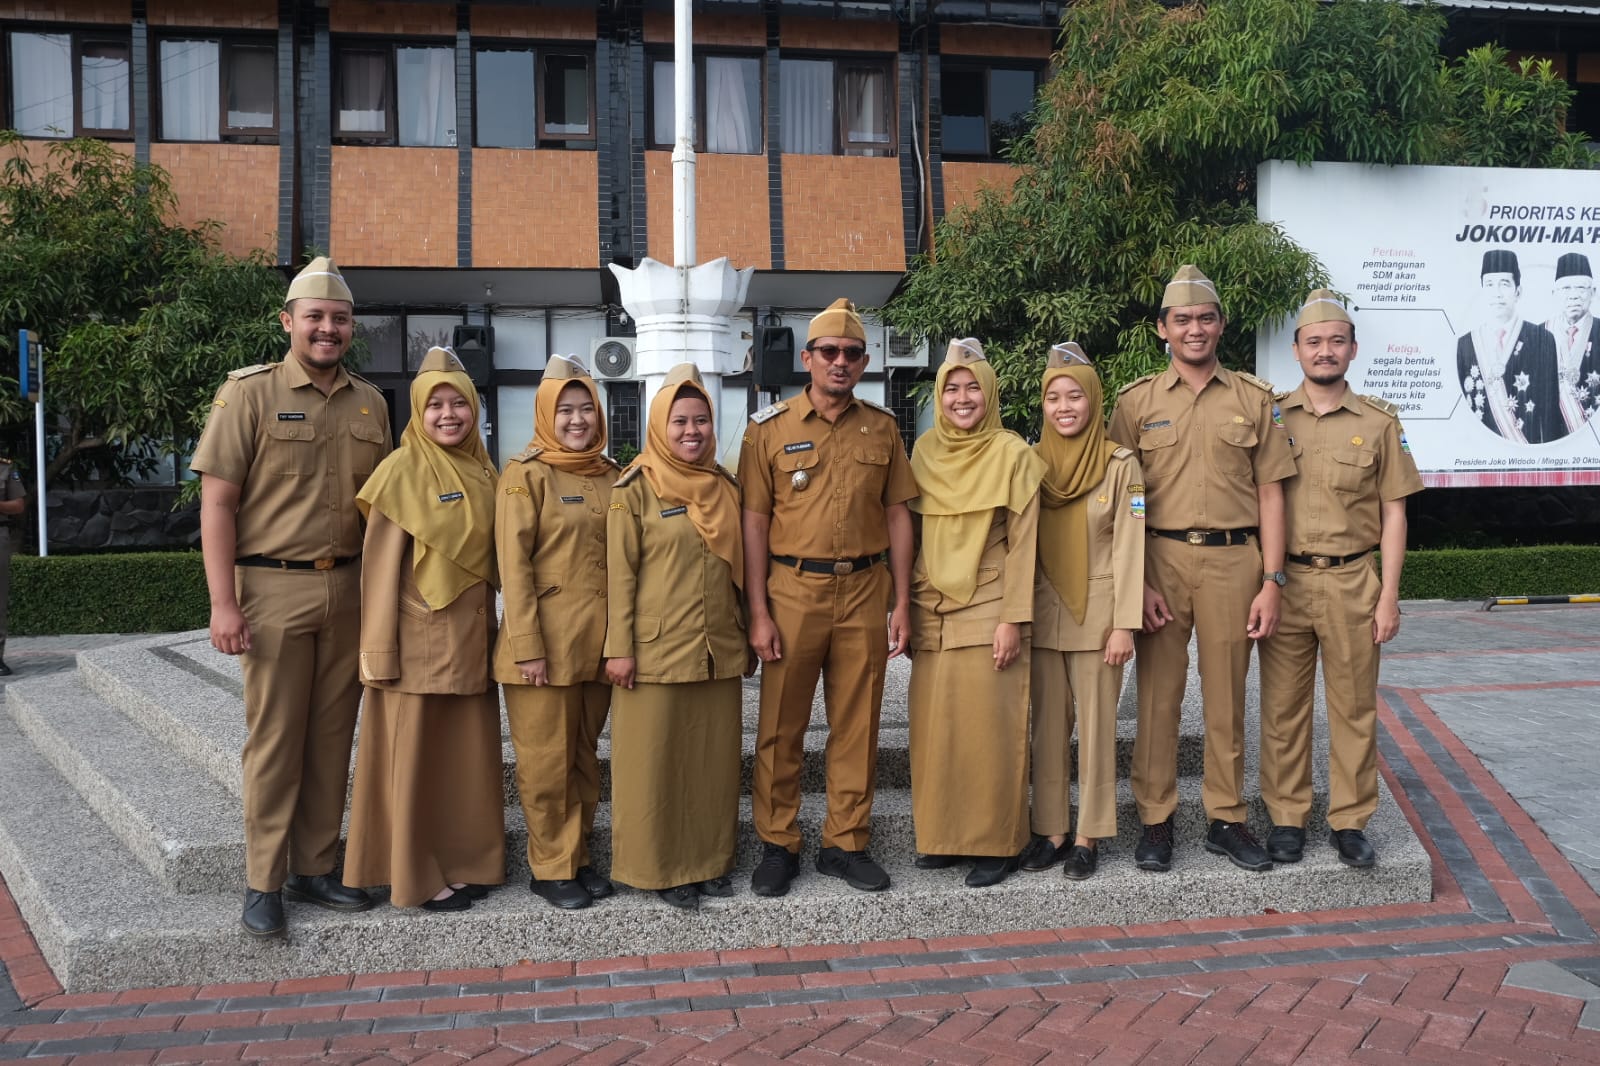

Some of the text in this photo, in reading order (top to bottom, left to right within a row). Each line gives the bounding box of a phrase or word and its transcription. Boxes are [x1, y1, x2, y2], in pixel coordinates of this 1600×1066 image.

[1490, 205, 1600, 221] PRIORITAS KE
[1362, 260, 1426, 270] pembangunan
[1372, 270, 1416, 280] SDM akan
[1356, 282, 1431, 292] menjadi prioritas
[1371, 293, 1417, 303] utama kita
[1387, 343, 1422, 355] Ketiga,
[1373, 356, 1436, 367] segala bentuk
[1367, 367, 1442, 379] kendala regulasi
[1363, 379, 1443, 390] harus kita potong,
[1381, 390, 1426, 400] harus kita
[1454, 458, 1487, 466] Presiden
[1488, 457, 1507, 466] Joko
[1508, 457, 1536, 466] Widodo
[1572, 456, 1581, 464] 20
